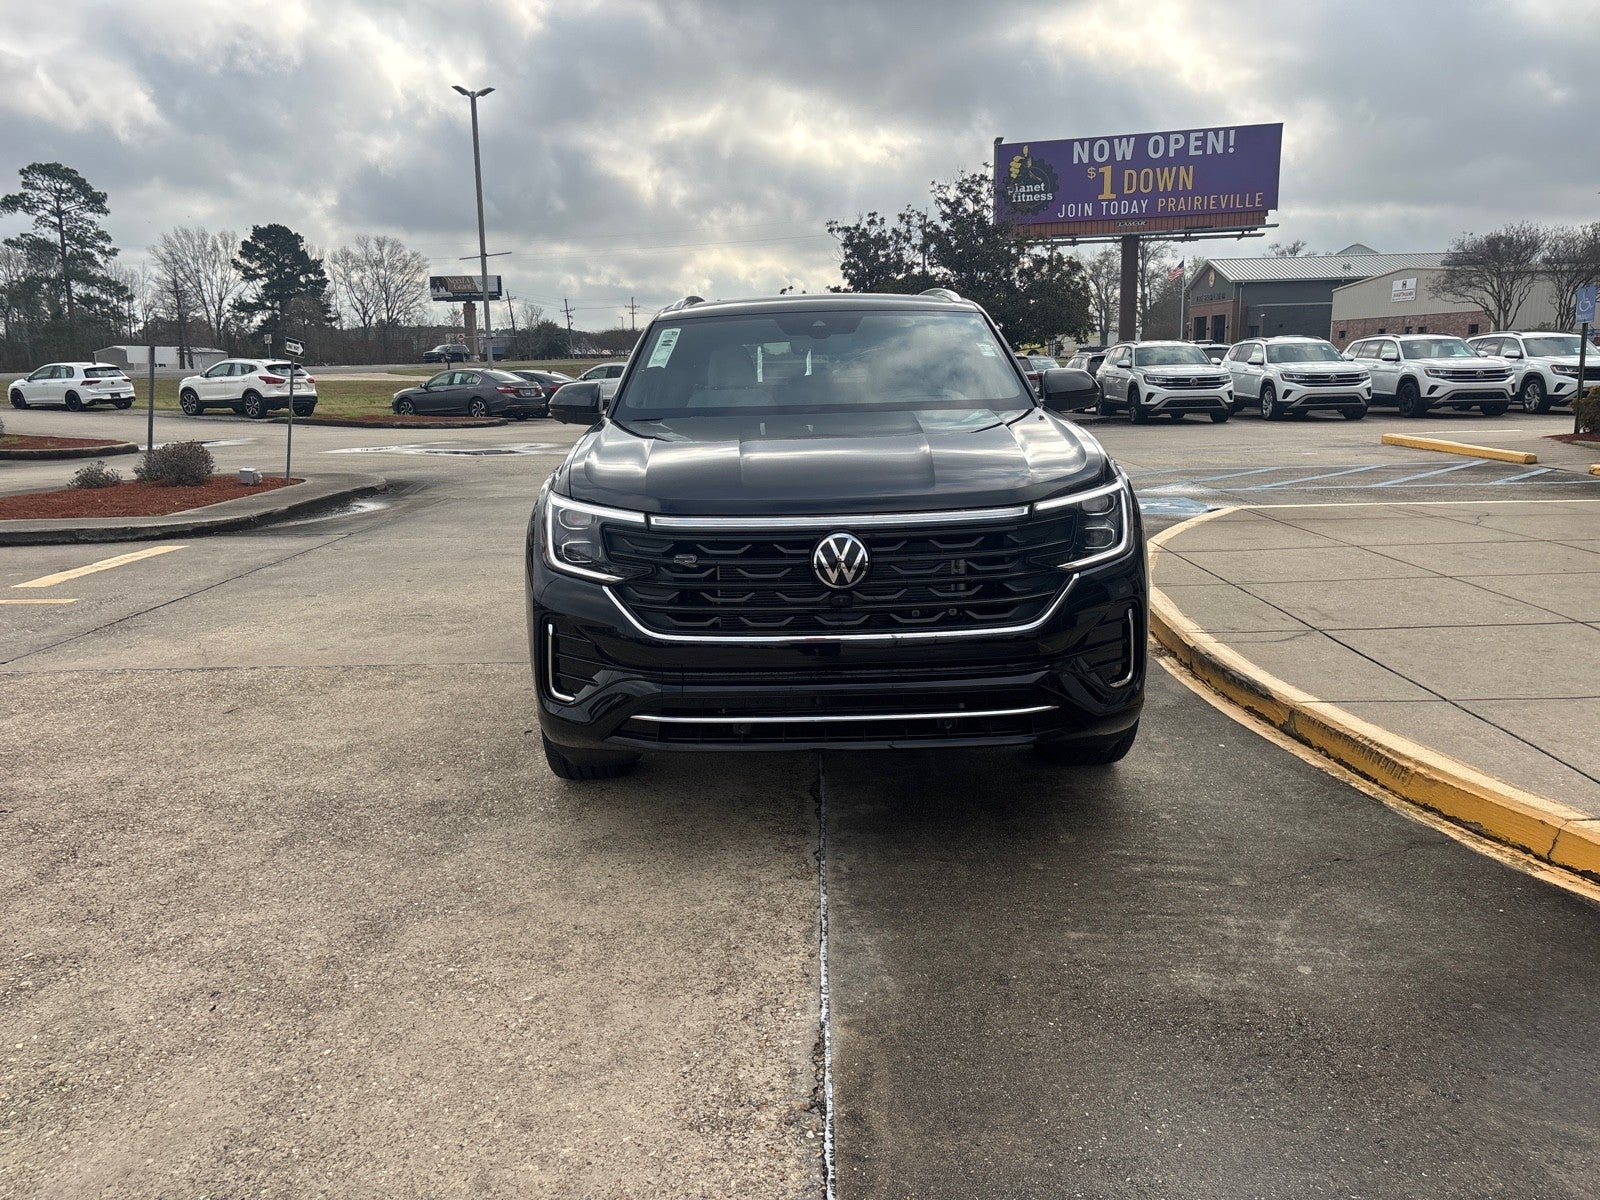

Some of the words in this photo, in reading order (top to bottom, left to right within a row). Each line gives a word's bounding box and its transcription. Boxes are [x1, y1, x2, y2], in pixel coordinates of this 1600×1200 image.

[1072, 137, 1136, 164] NOW
[1147, 129, 1236, 159] OPEN!
[1123, 165, 1194, 194] DOWN
[1011, 192, 1053, 203] fitness
[1057, 202, 1093, 218] JOIN
[1101, 199, 1149, 215] TODAY
[1157, 192, 1264, 212] PRAIRIEVILLE
